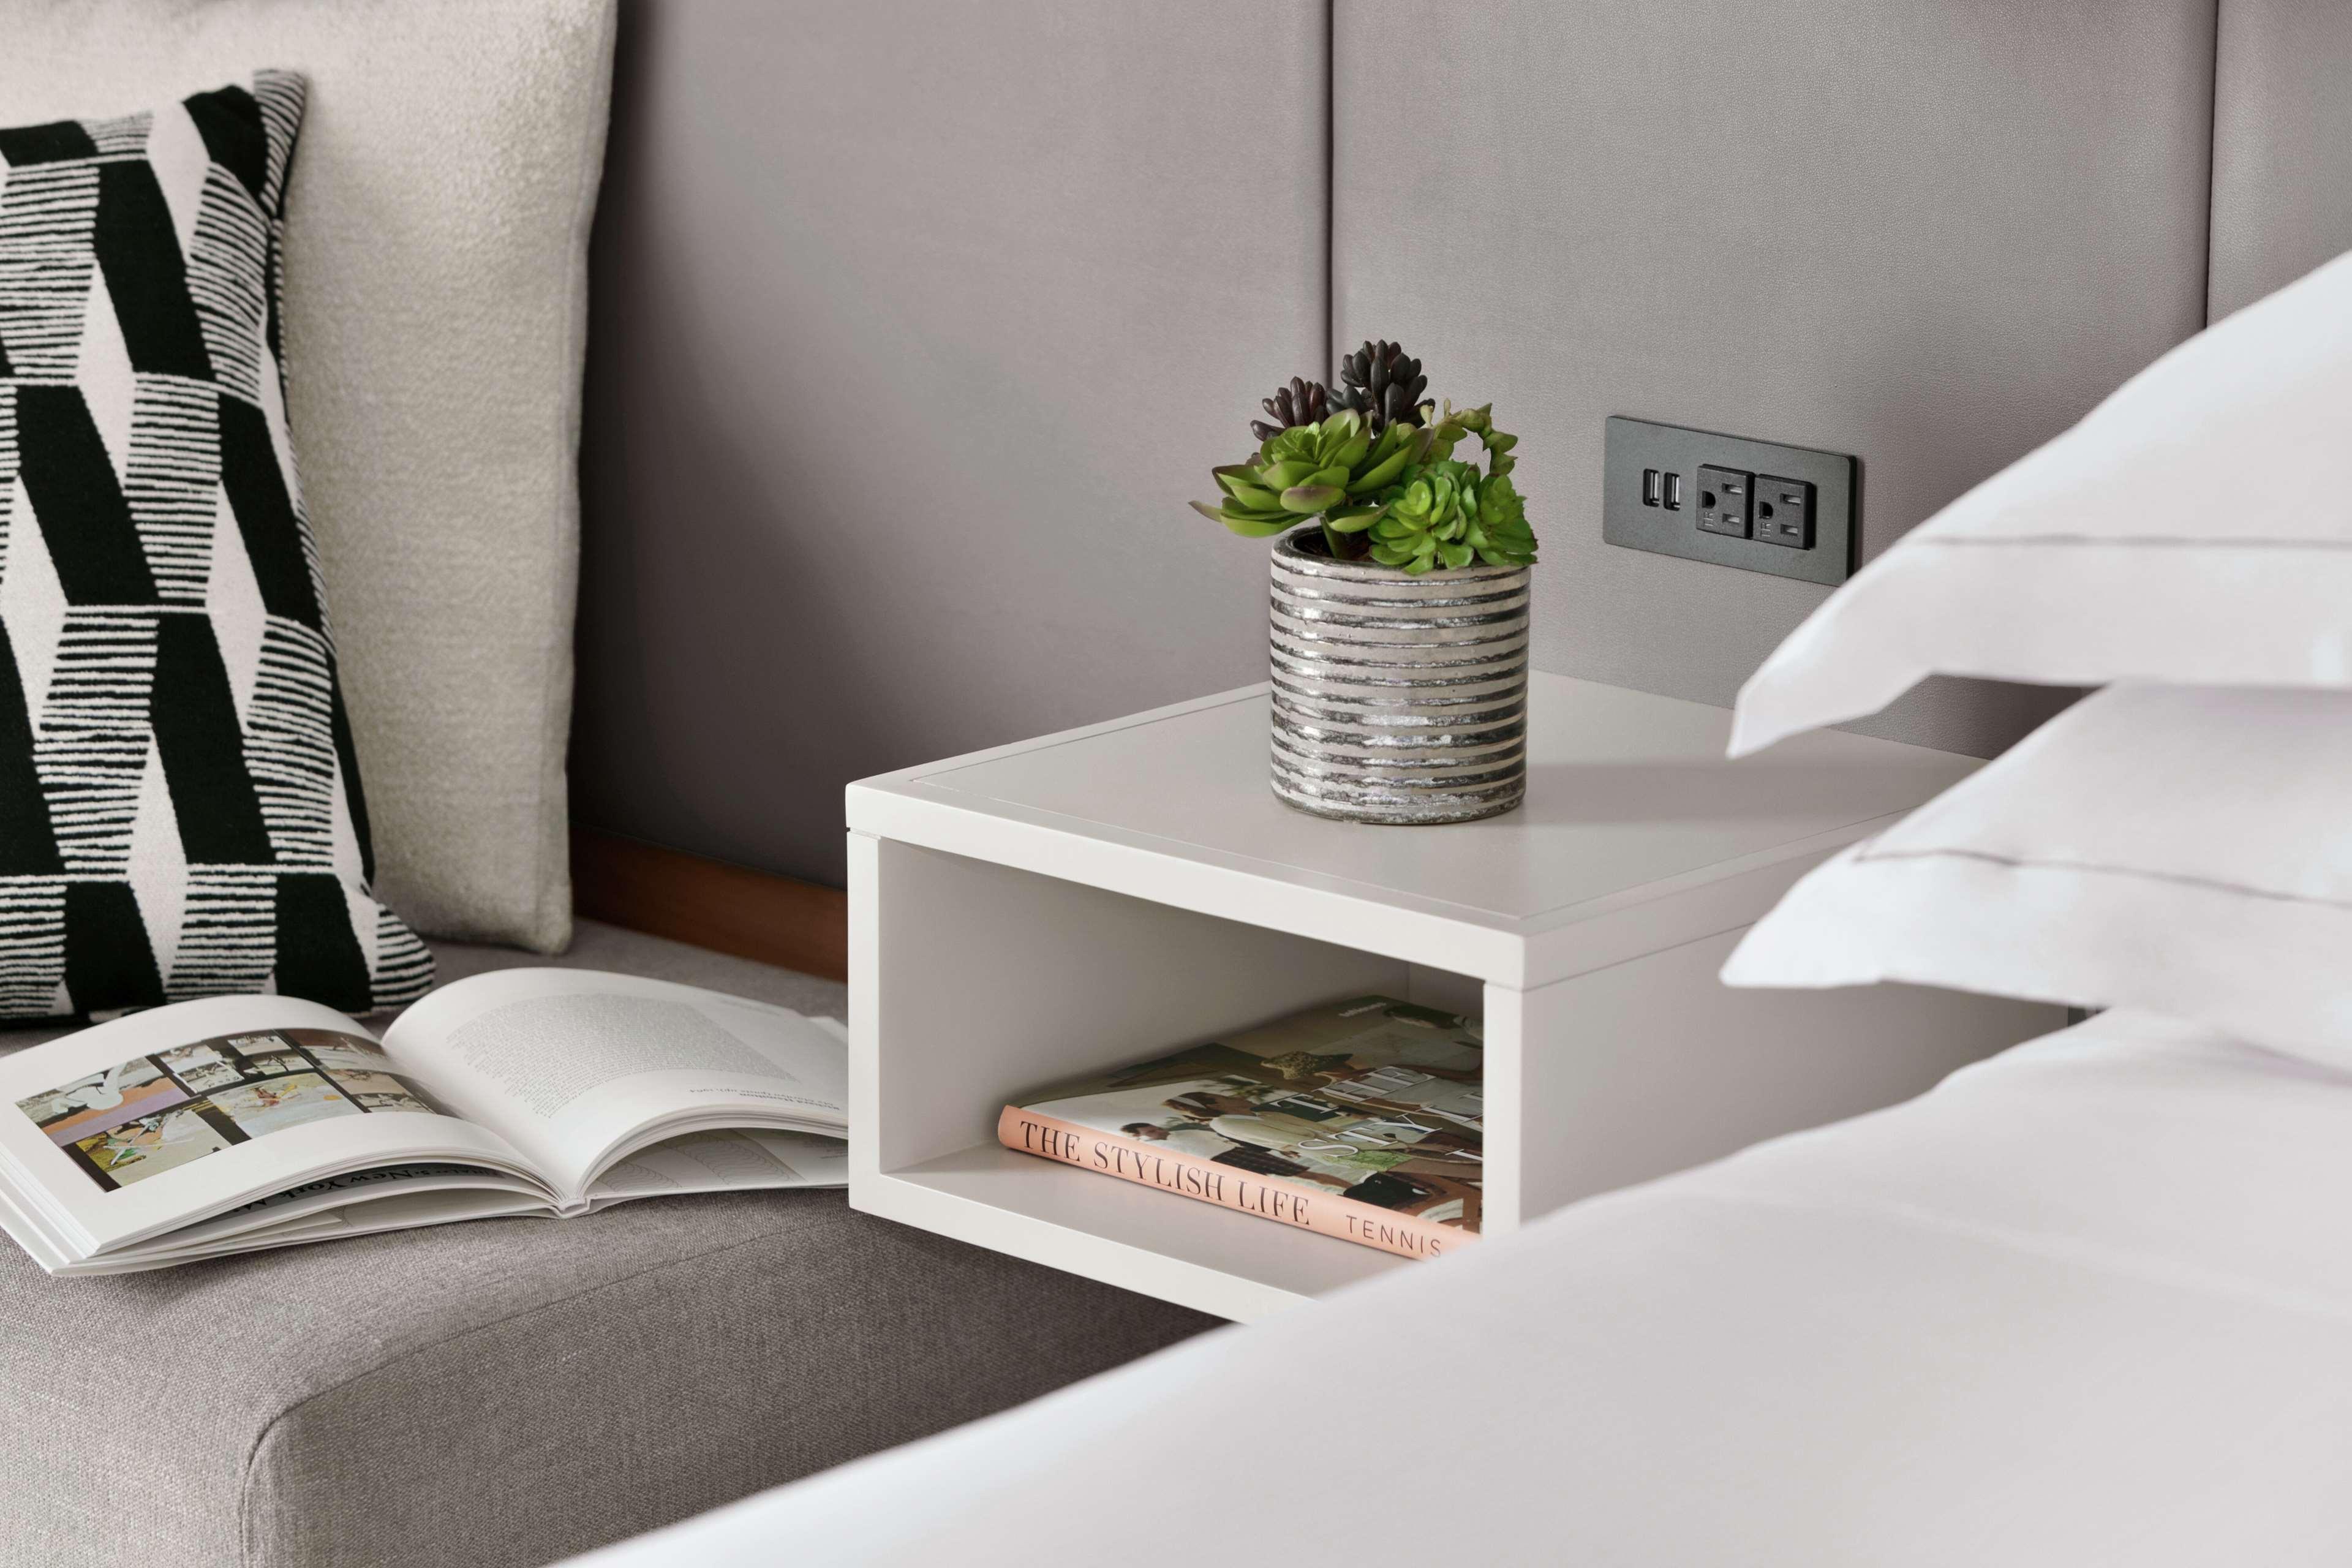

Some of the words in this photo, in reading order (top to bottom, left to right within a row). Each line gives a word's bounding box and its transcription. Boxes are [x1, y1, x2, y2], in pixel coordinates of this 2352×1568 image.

[1269, 1066, 1436, 1114] THE
[350, 1169, 413, 1184] New
[1019, 1120, 1081, 1163] THE
[1093, 1141, 1226, 1202] STYLISH
[1237, 1180, 1310, 1226] LIFE
[1345, 1214, 1442, 1259] TENNIS
